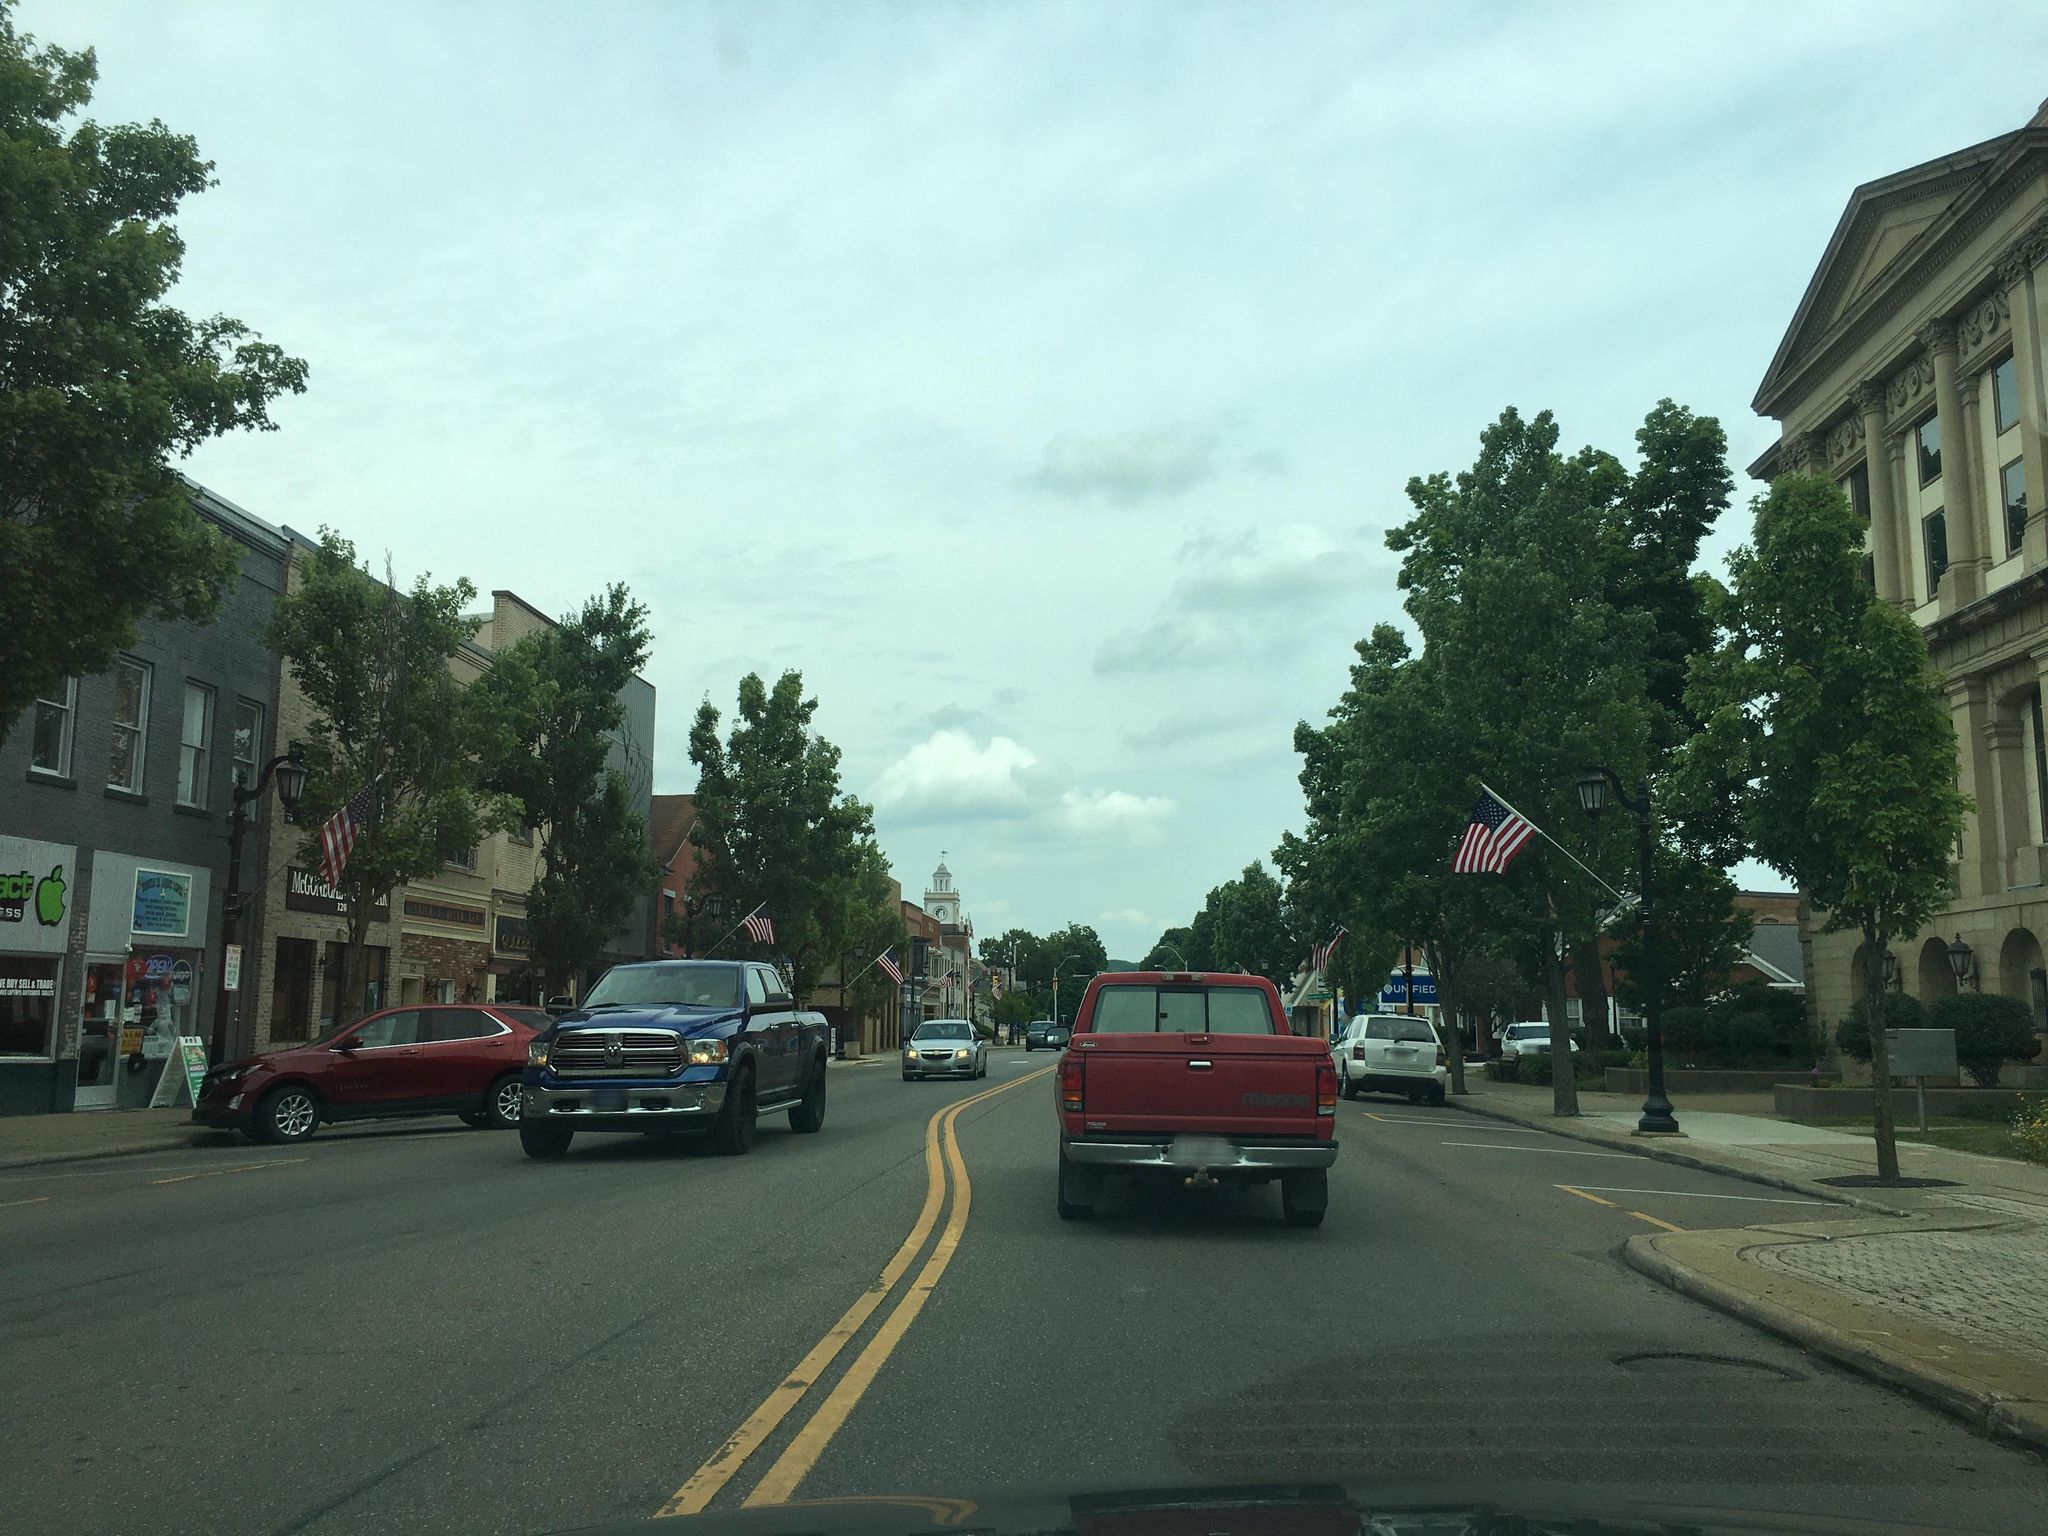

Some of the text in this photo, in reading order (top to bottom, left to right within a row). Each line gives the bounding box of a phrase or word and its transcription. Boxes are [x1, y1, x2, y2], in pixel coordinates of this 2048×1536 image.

[18, 978, 31, 989] SELL
[31, 980, 36, 988] &
[36, 979, 54, 989] TRADE
[1393, 984, 1437, 994] UNFIED
